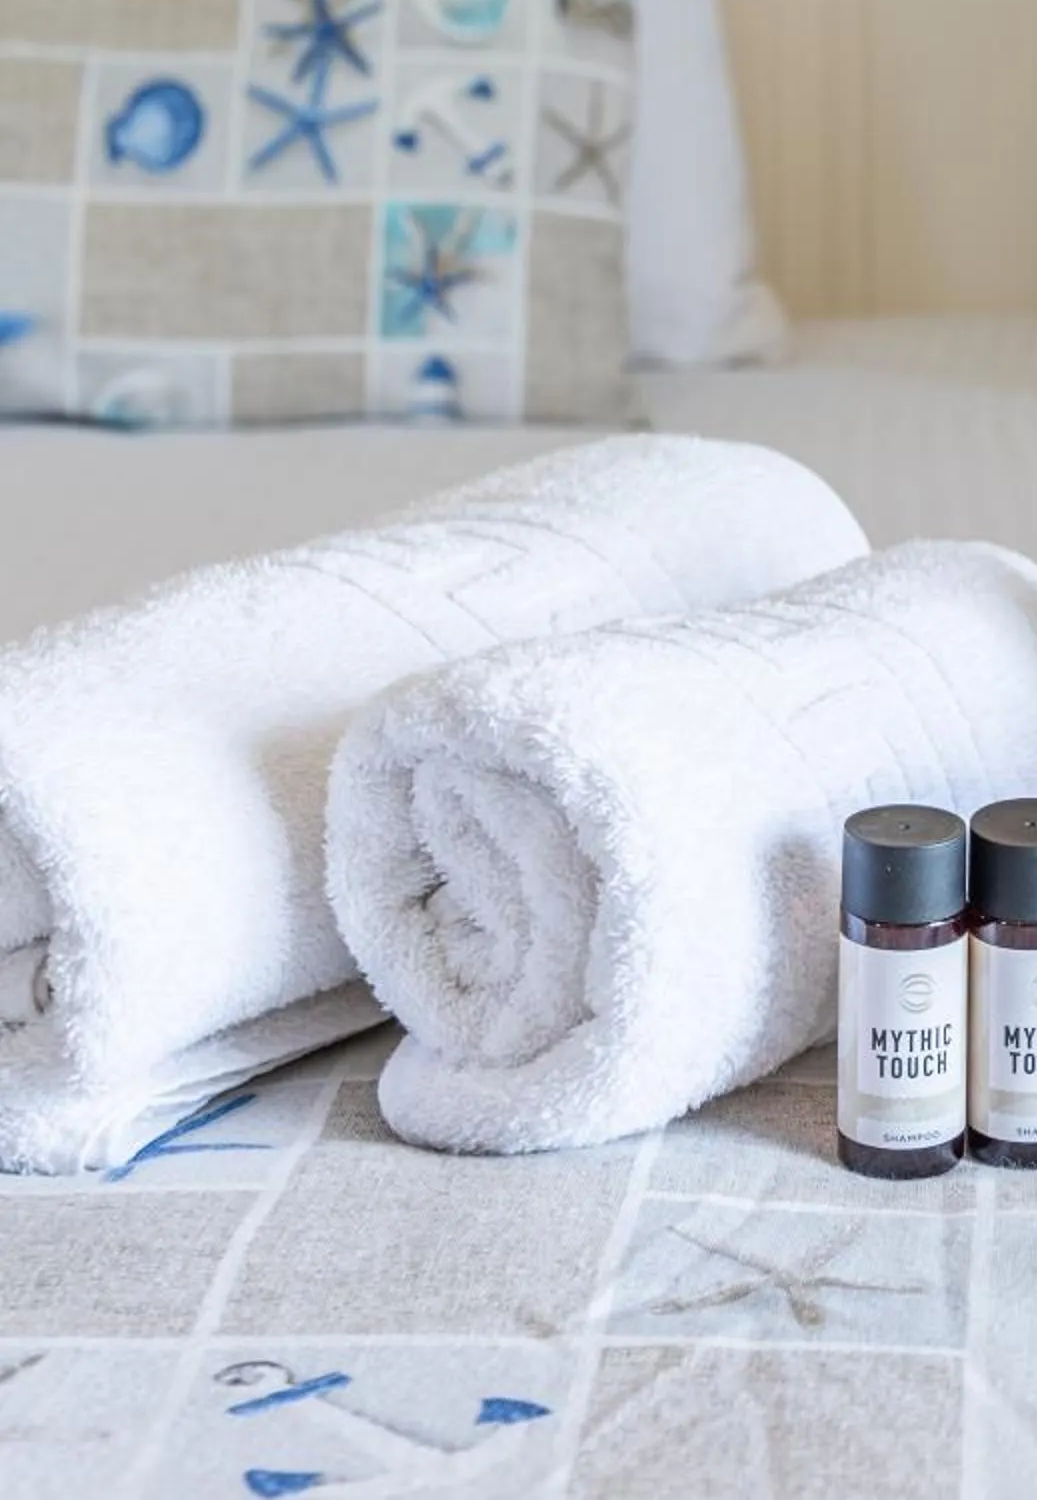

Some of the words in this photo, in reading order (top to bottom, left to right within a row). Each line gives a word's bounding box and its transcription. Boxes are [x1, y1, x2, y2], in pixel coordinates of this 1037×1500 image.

[871, 1023, 953, 1053] MYTHIC
[876, 1051, 948, 1079] TOUCH
[882, 1130, 942, 1143] SHAMPOO
